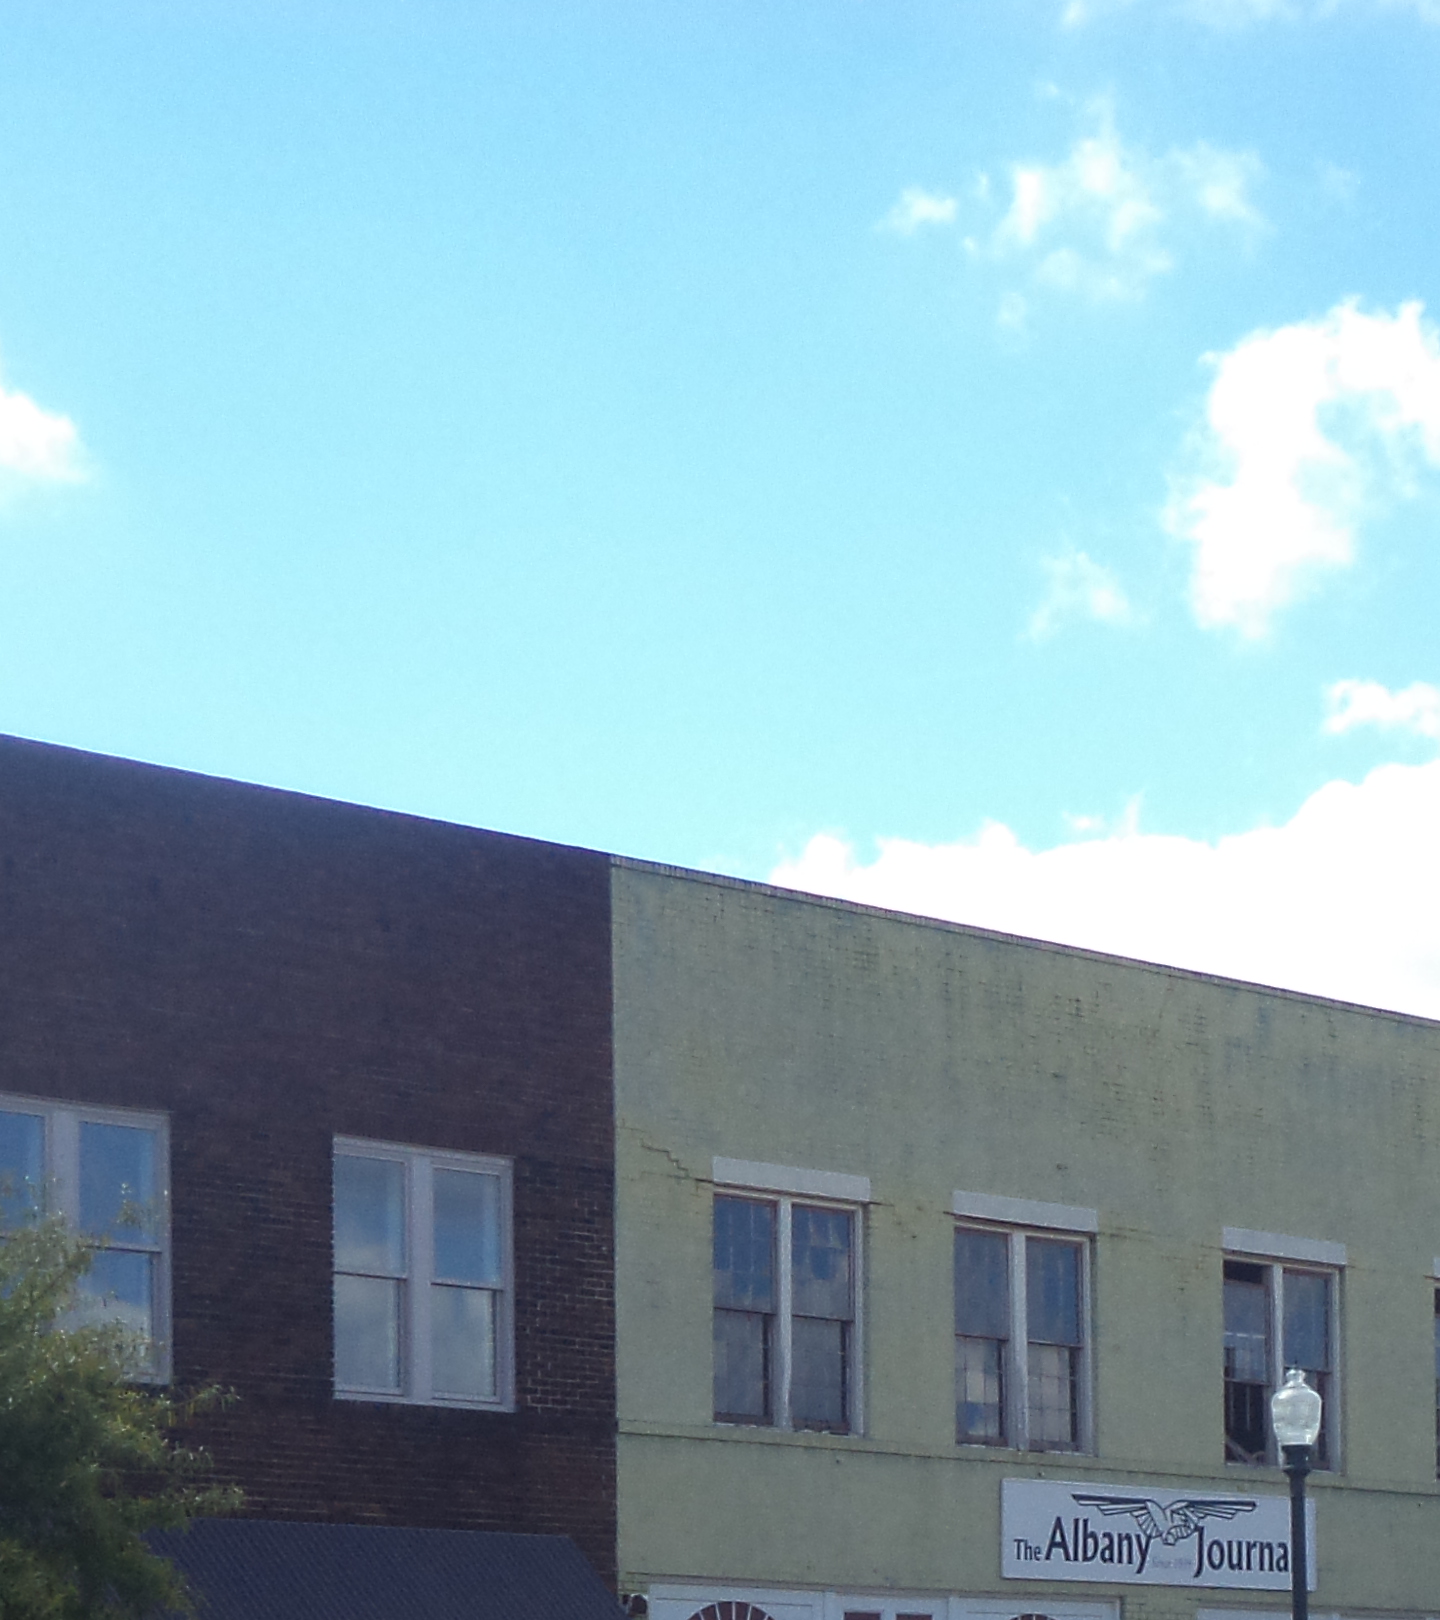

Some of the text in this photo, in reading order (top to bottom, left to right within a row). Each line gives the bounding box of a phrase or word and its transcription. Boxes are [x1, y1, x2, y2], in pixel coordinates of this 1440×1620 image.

[1013, 1516, 1291, 1578] The Albany Journa
